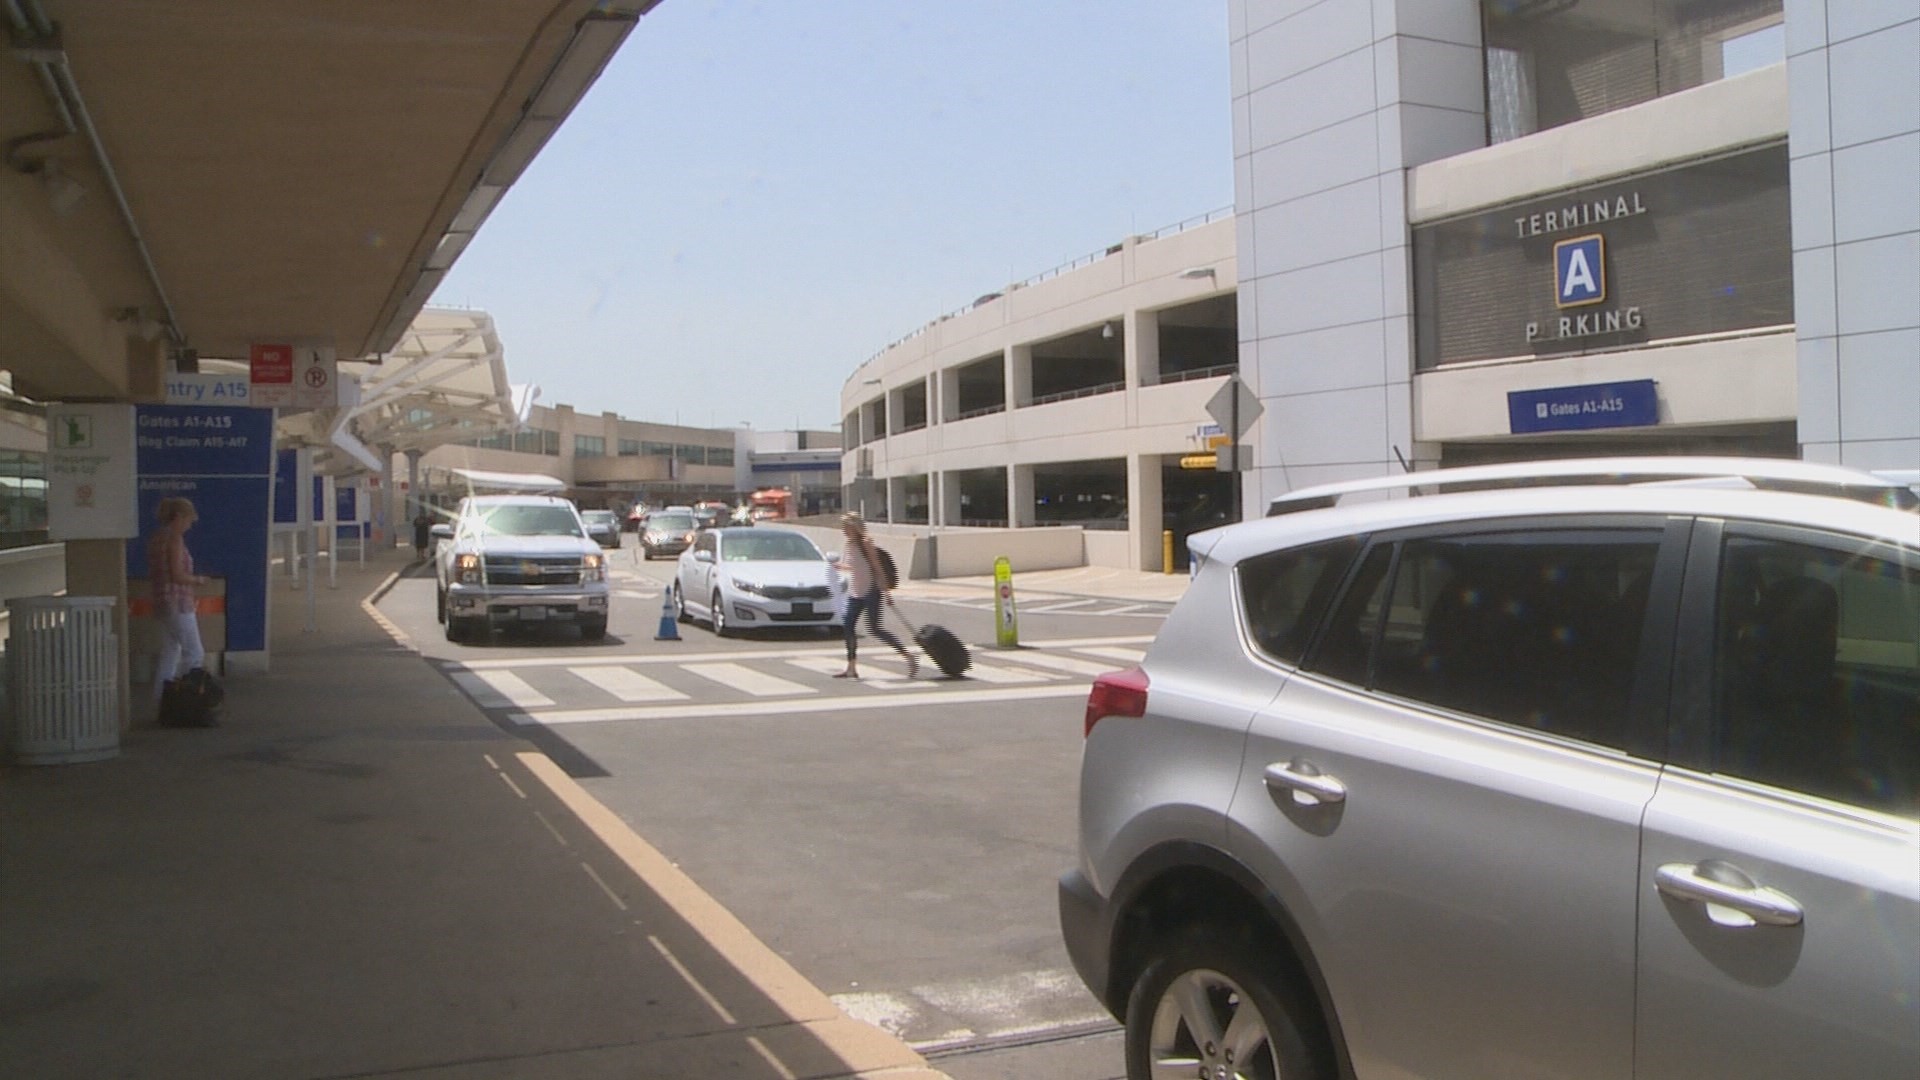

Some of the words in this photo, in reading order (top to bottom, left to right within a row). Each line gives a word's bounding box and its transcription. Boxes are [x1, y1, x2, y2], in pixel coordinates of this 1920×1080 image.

[1515, 191, 1647, 239] TERMINAL
[1563, 248, 1597, 297] A
[1526, 306, 1642, 343] PRKING
[165, 381, 206, 400] ntry
[213, 382, 248, 398] A15
[1550, 402, 1580, 416] Gates
[1582, 397, 1624, 413] A1-A15
[139, 414, 179, 428] Gates
[183, 415, 233, 428] A1-A15
[165, 435, 201, 448] Claim
[140, 480, 198, 491] American
